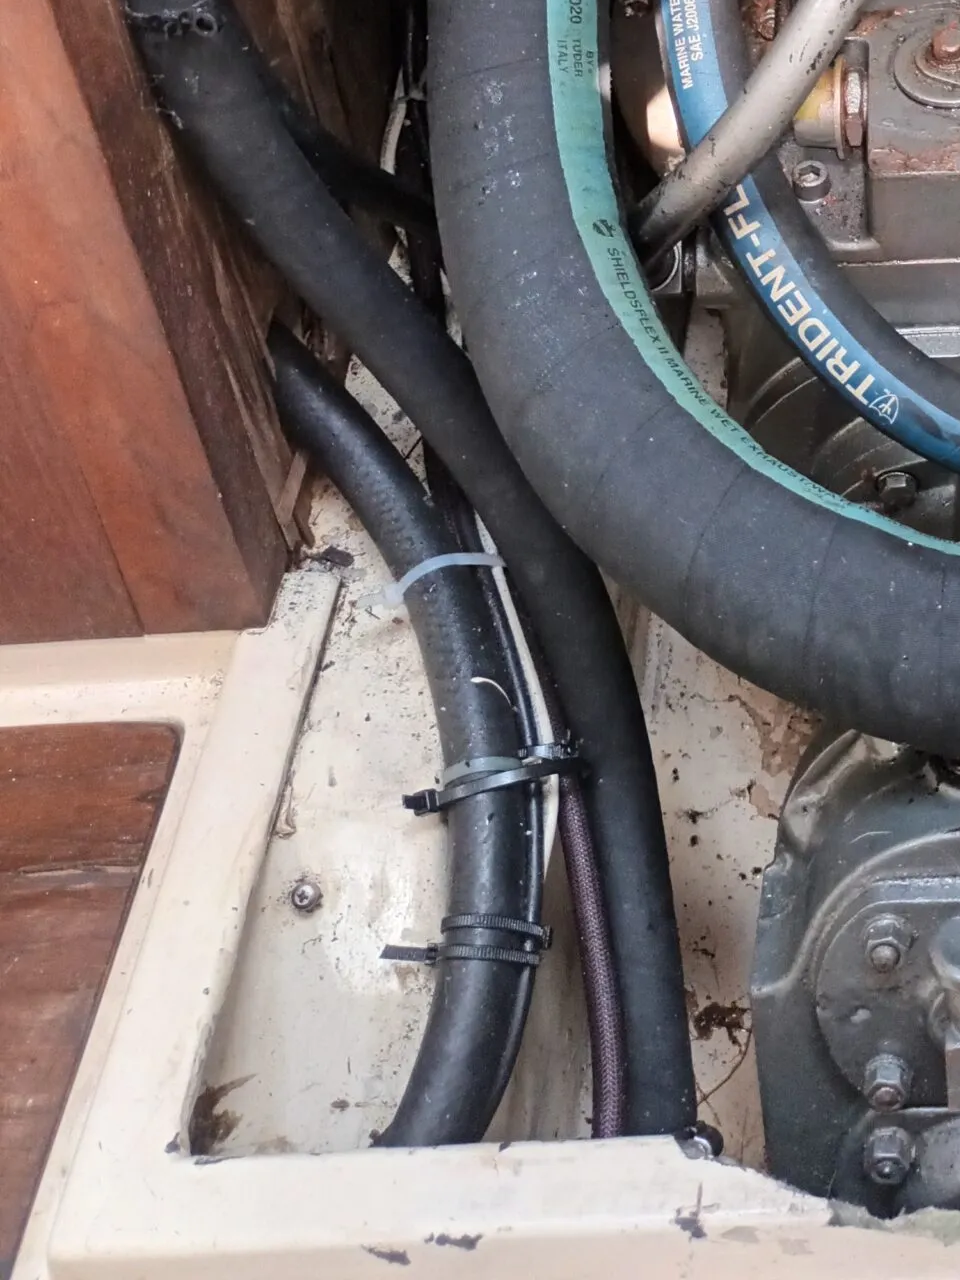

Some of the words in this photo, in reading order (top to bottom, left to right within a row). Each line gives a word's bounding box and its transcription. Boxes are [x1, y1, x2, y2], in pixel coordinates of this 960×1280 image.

[675, 37, 693, 89] MARINE
[688, 34, 704, 61] SAE
[607, 247, 662, 344] SHIELDSFLEX
[665, 357, 712, 407] MARINE
[710, 406, 742, 434] WET
